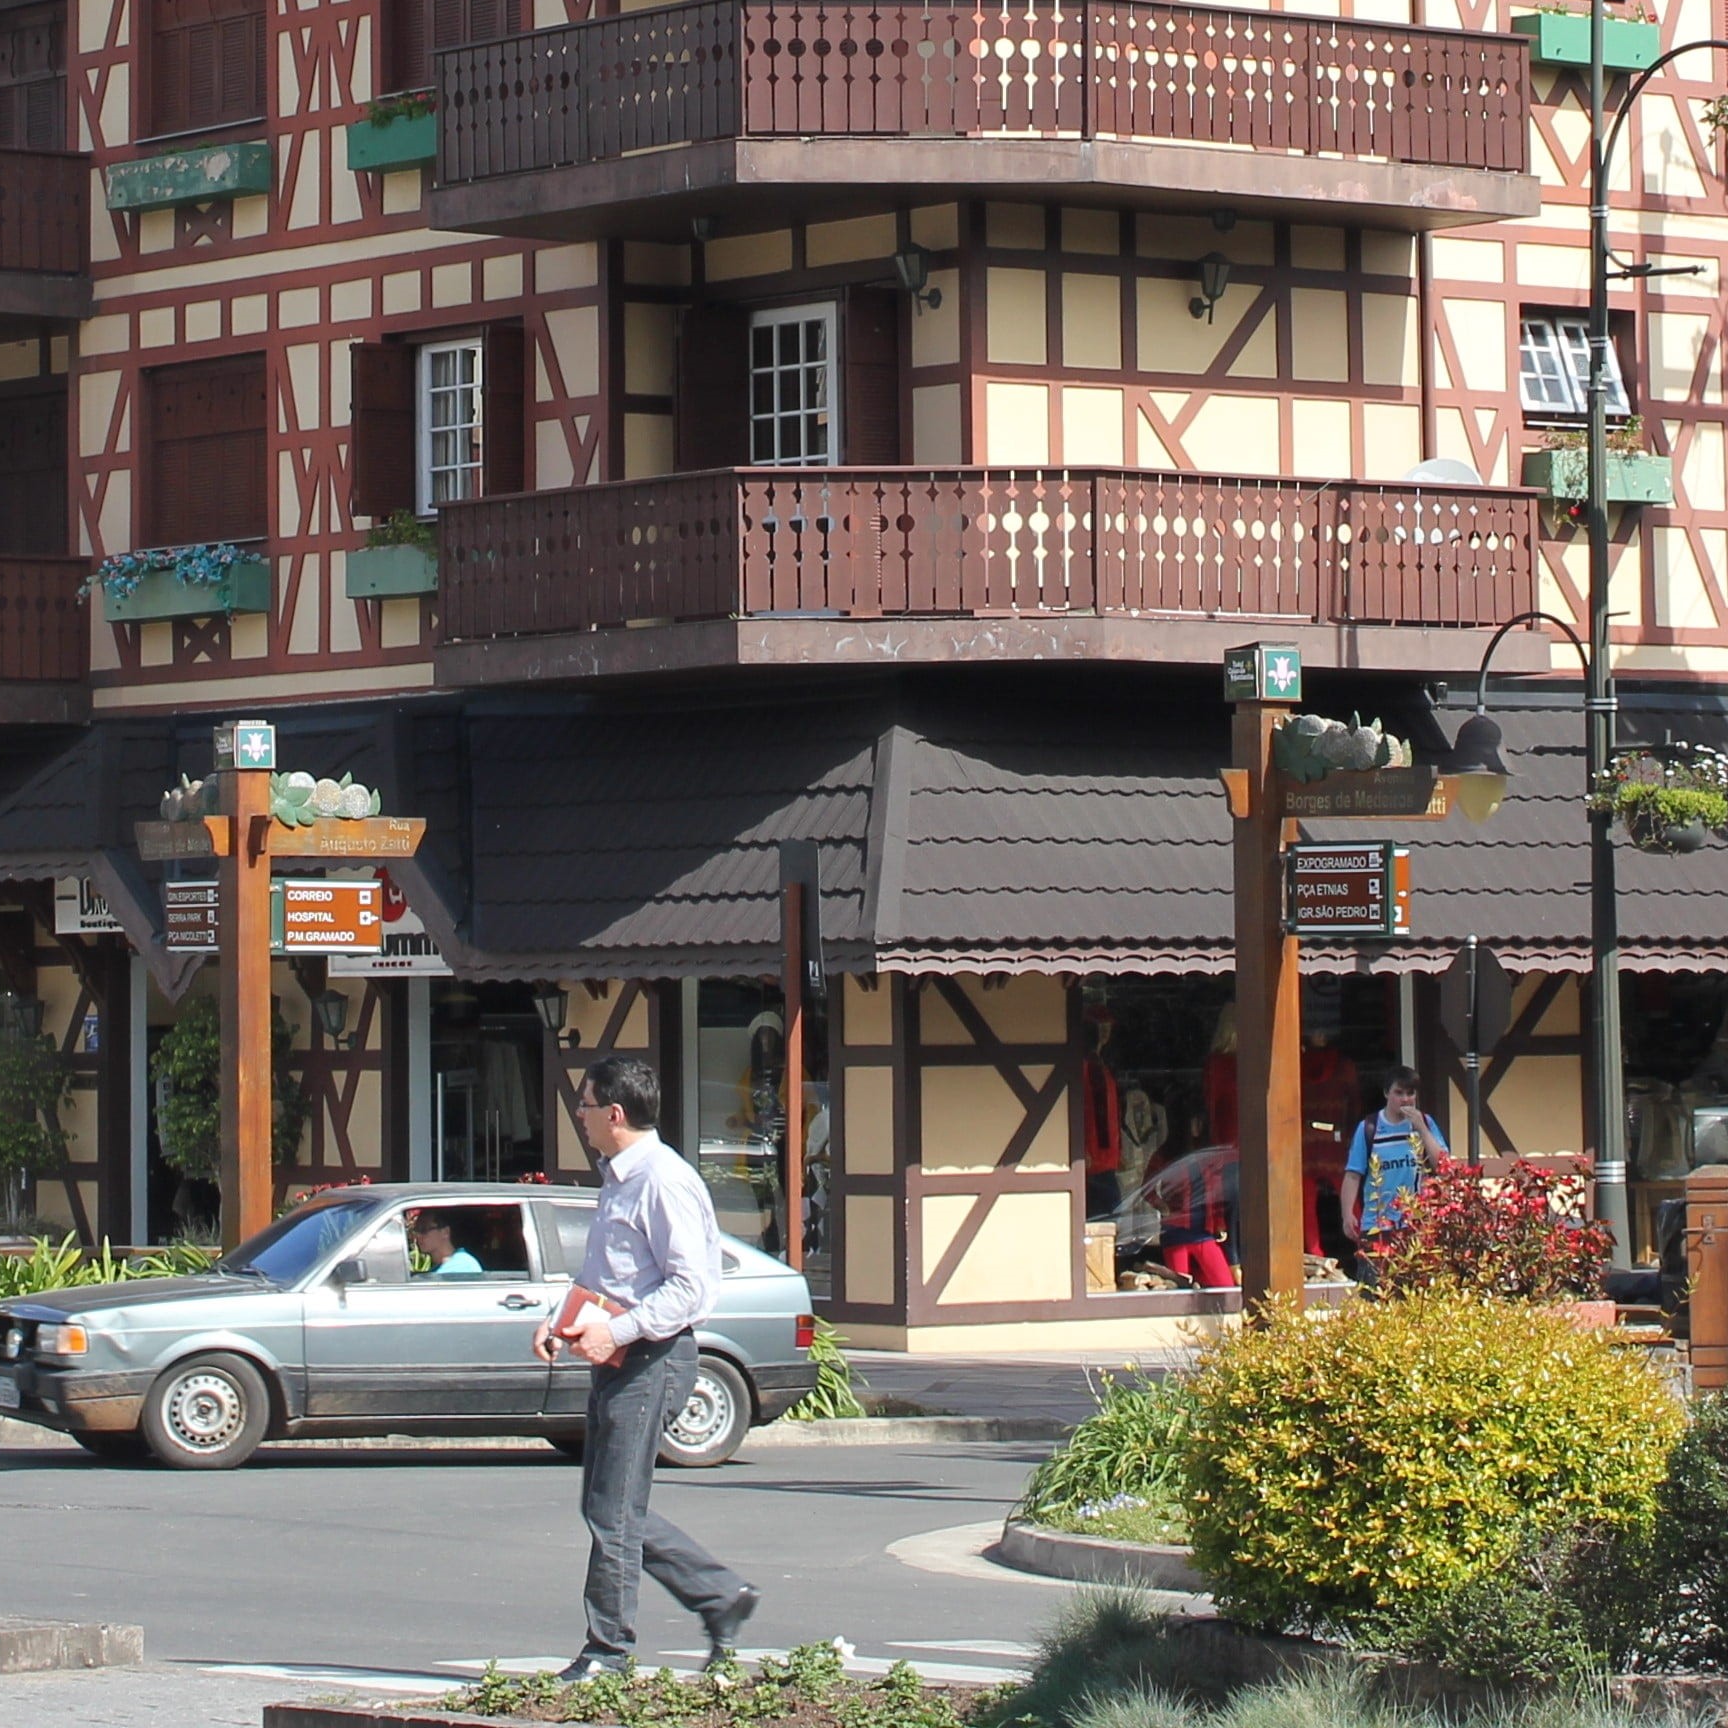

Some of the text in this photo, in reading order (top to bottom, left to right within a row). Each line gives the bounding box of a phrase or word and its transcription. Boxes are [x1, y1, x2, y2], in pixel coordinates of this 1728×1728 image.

[1286, 791, 1330, 814] Borges
[1335, 791, 1352, 810] de
[389, 819, 411, 832] Rua
[320, 836, 377, 853] Augusto
[1297, 856, 1367, 869] EXPOGRAMADO
[287, 890, 333, 902] CORREIO
[1297, 883, 1349, 898] PÇA ETNIAS
[187, 913, 202, 922] PARK
[287, 911, 335, 923] HOSPITAL
[1335, 906, 1368, 918] PEDRO
[287, 931, 355, 943] P.M.GRAMADO
